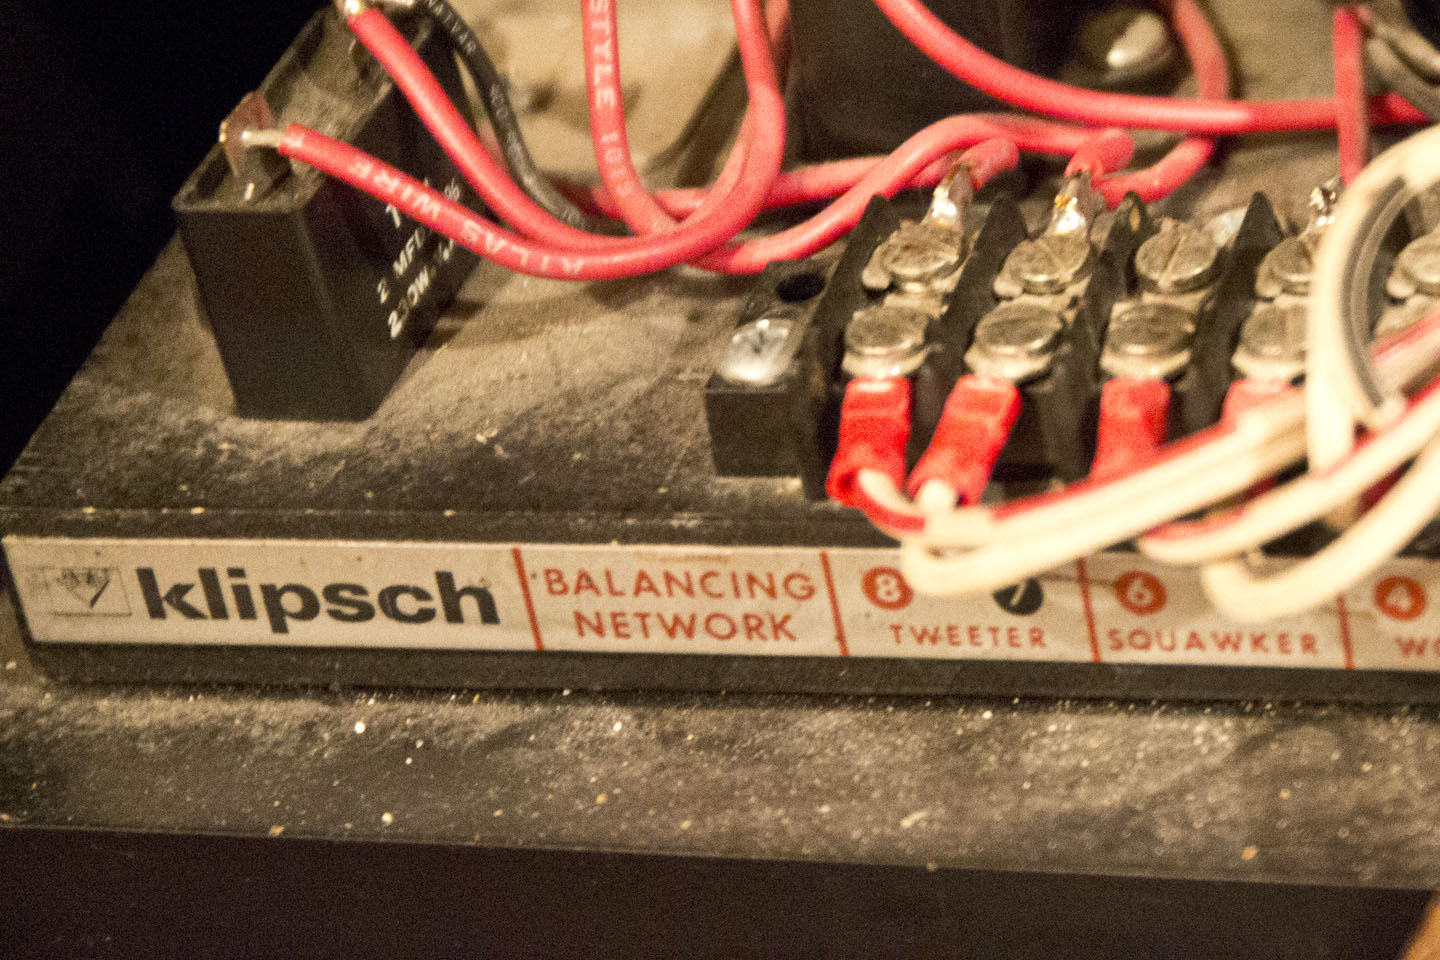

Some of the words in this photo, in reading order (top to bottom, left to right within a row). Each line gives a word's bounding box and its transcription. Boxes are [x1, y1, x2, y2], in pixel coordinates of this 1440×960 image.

[350, 156, 440, 220] WIRE
[137, 566, 501, 633] klipsch
[544, 568, 816, 601] BALANCING
[573, 609, 797, 641] NETWORK
[889, 624, 1047, 648] TWEETER
[1107, 628, 1319, 655] SQUAWKER
